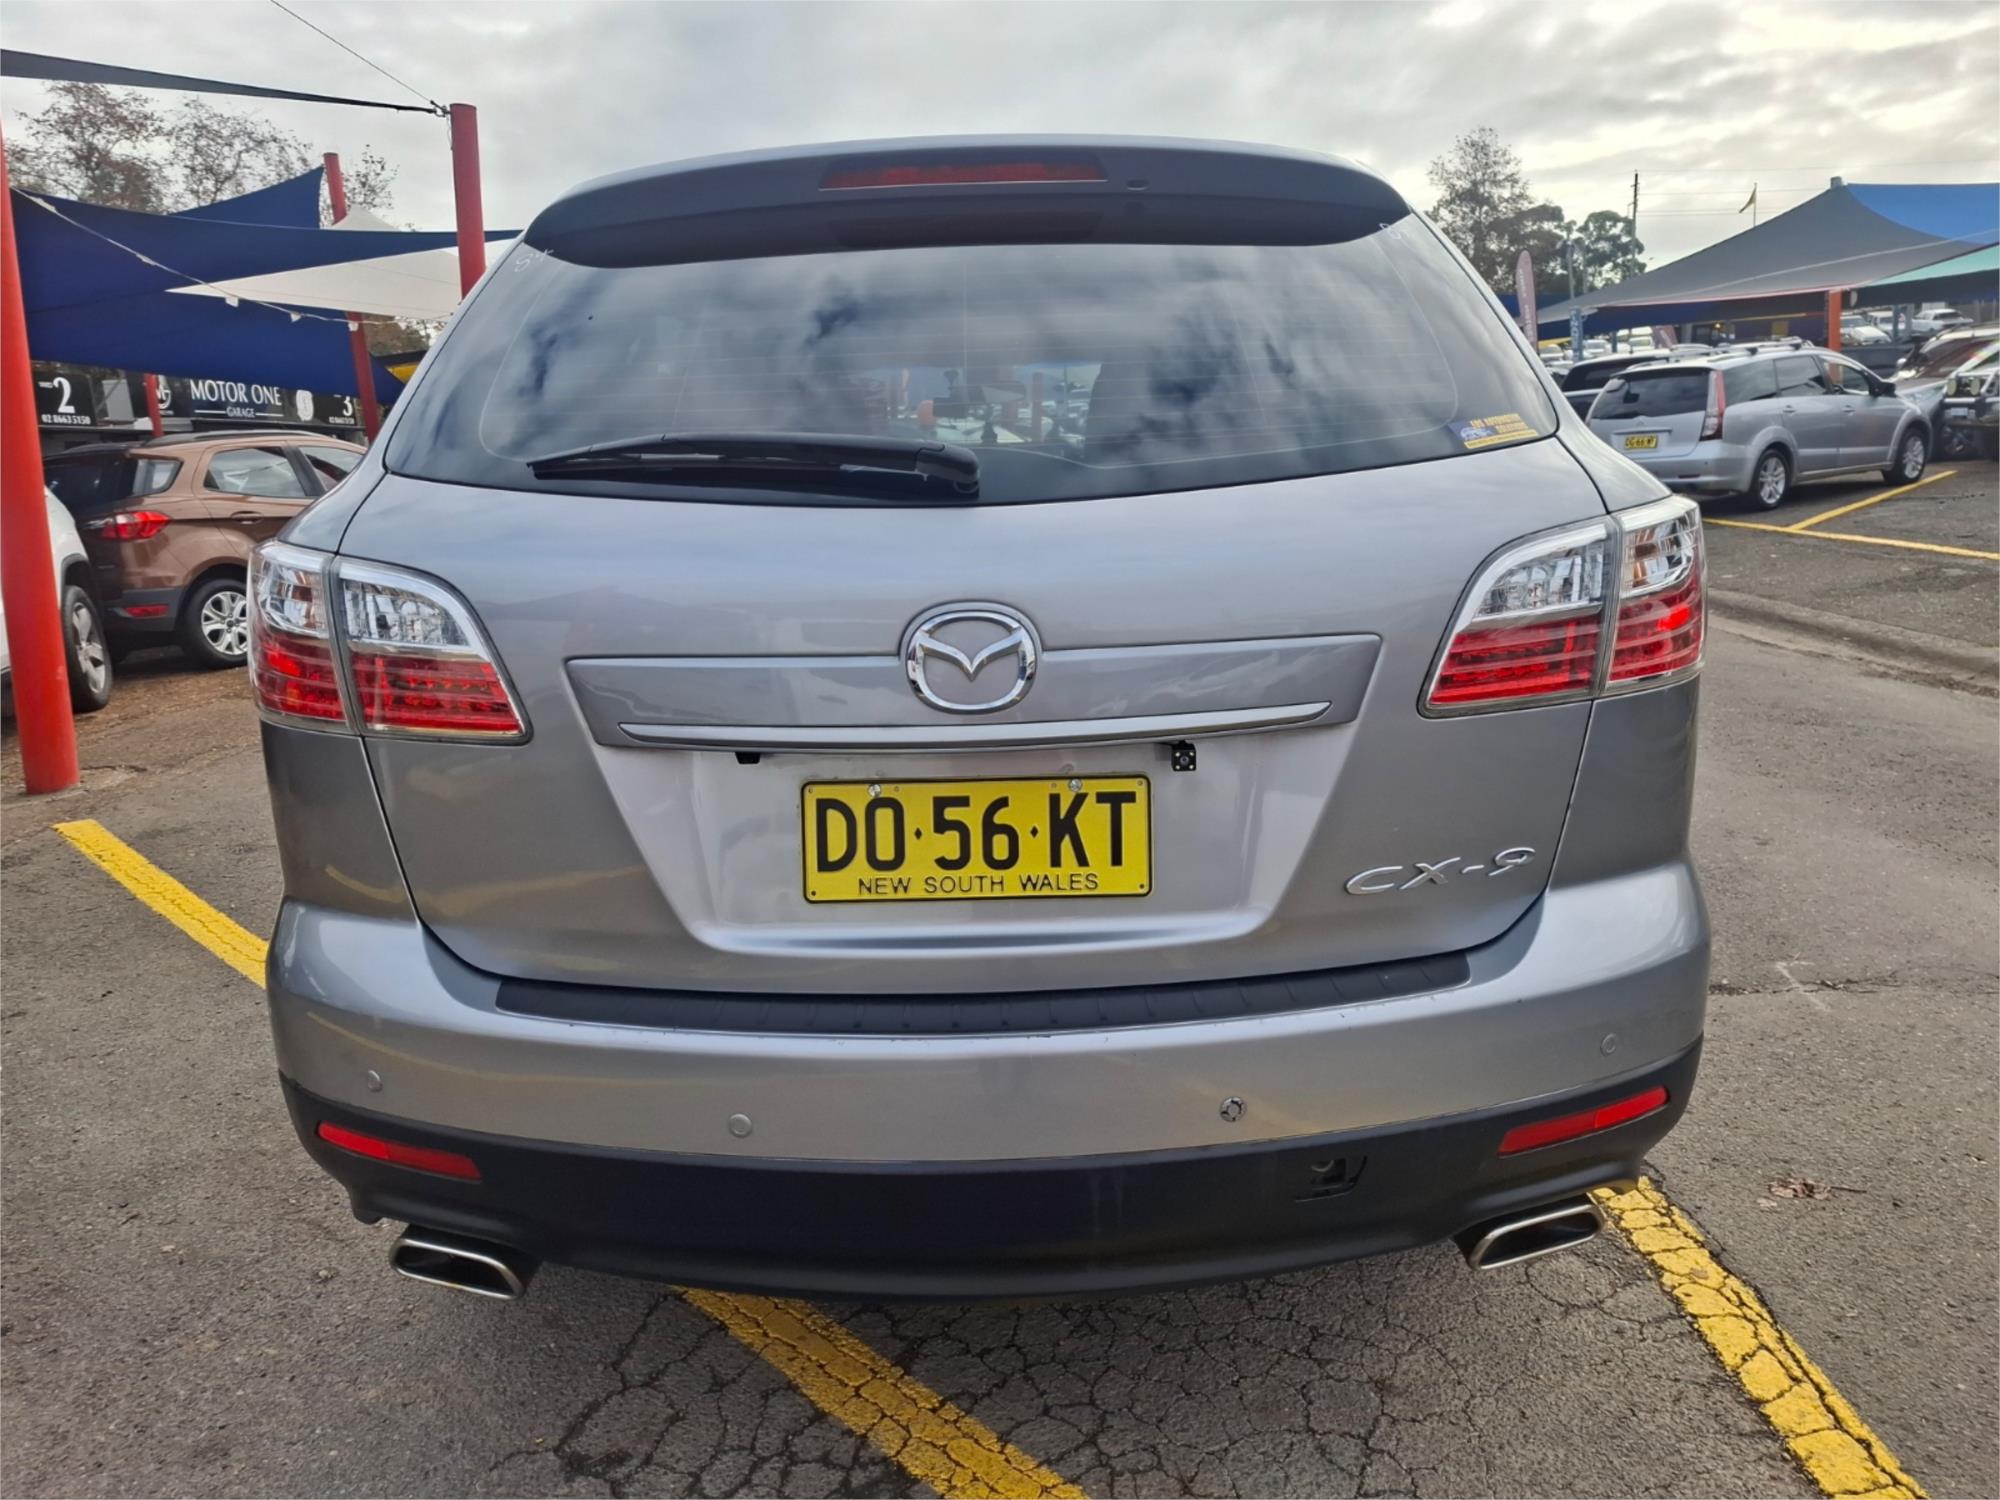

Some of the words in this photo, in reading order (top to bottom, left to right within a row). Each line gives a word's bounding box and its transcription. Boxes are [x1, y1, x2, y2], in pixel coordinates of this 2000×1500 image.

[52, 376, 75, 414] 2
[190, 379, 248, 402] MOTOR
[251, 384, 282, 405] ONE
[226, 406, 255, 418] GARAGE
[1345, 846, 1536, 895] CX-9
[858, 876, 911, 896] NEW
[923, 874, 1005, 894] SOUTH
[1019, 872, 1099, 892] WALES
